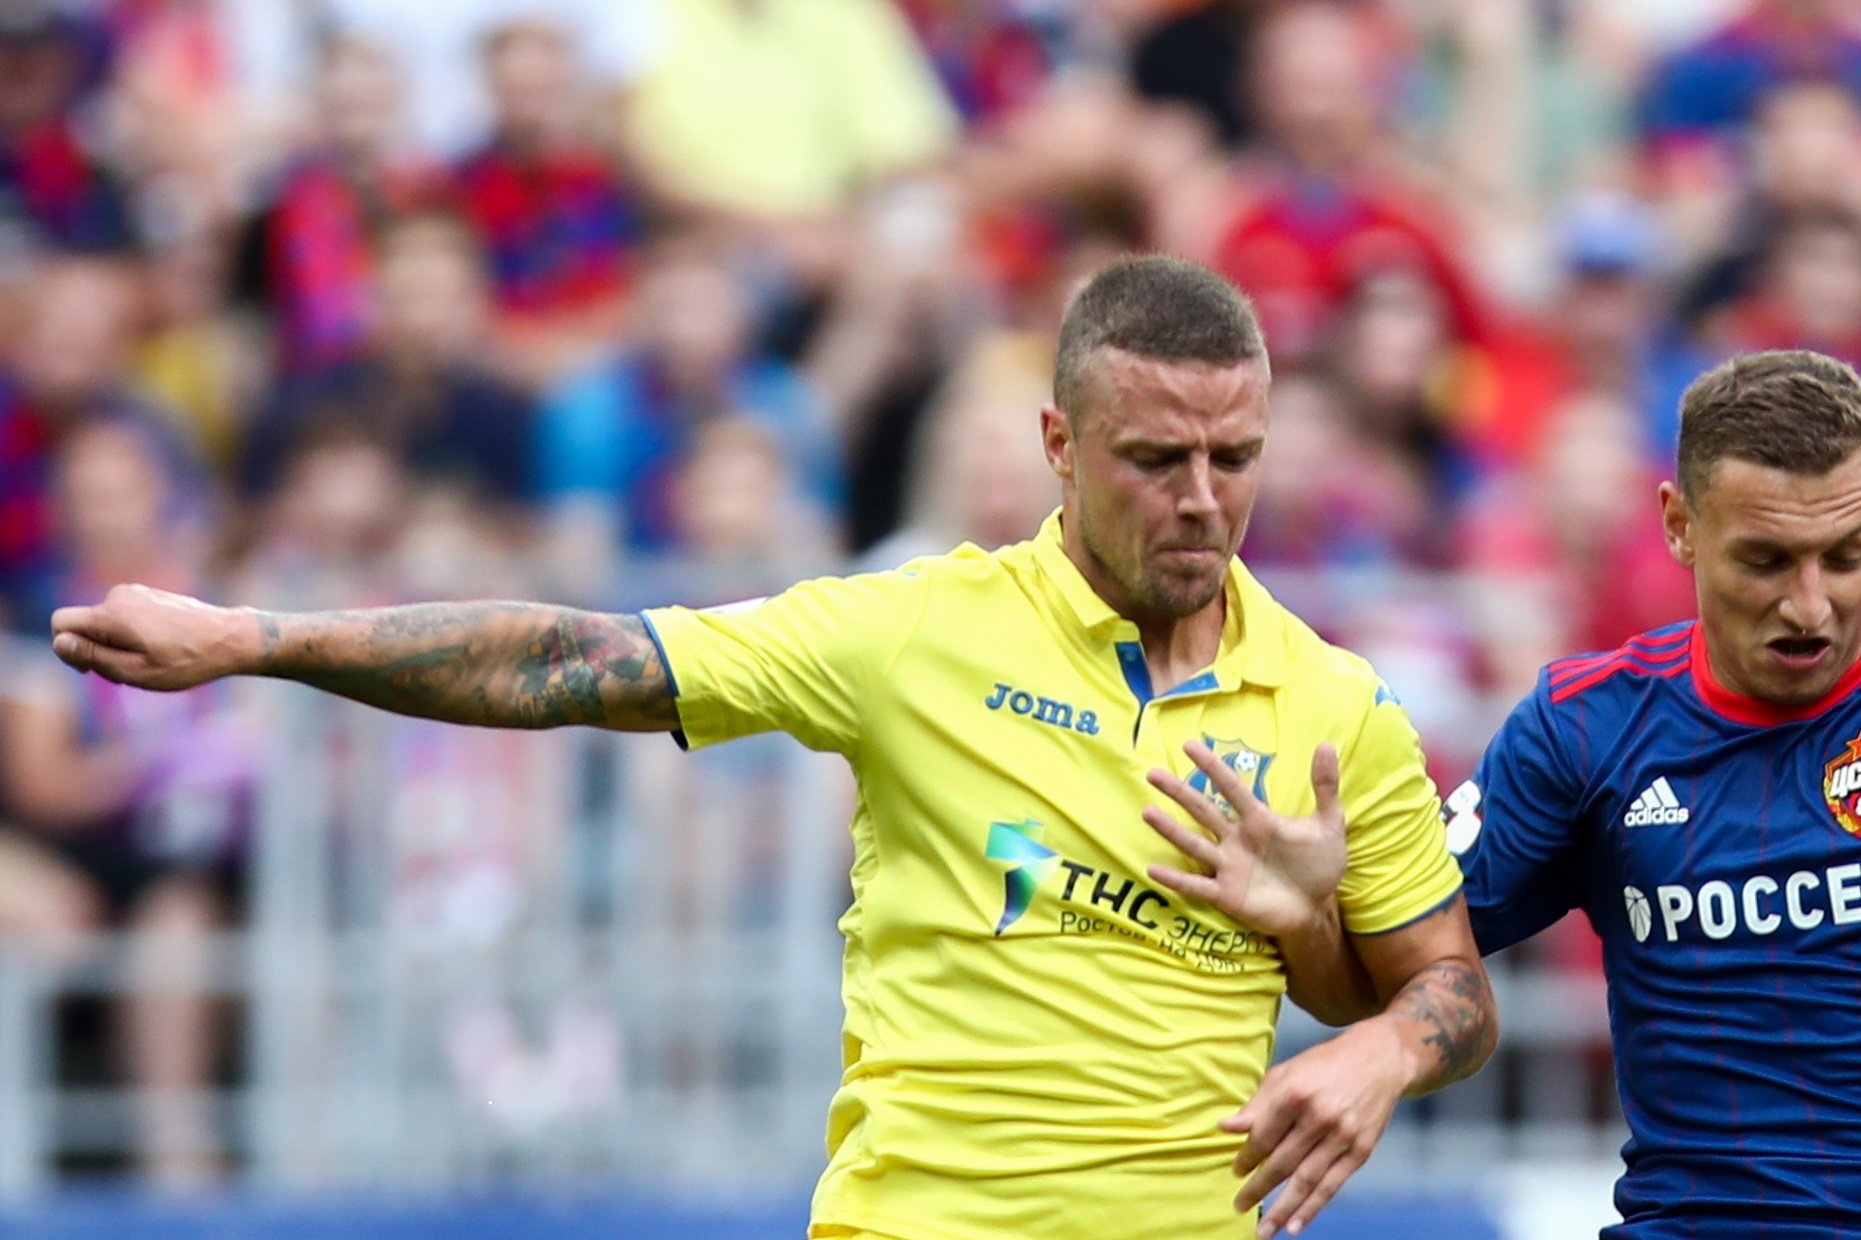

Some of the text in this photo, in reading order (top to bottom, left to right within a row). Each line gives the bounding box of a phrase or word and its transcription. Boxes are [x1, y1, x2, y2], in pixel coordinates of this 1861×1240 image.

[984, 683, 1099, 735] Joma
[1623, 806, 1690, 828] adidas
[1060, 860, 1170, 930] ТНС
